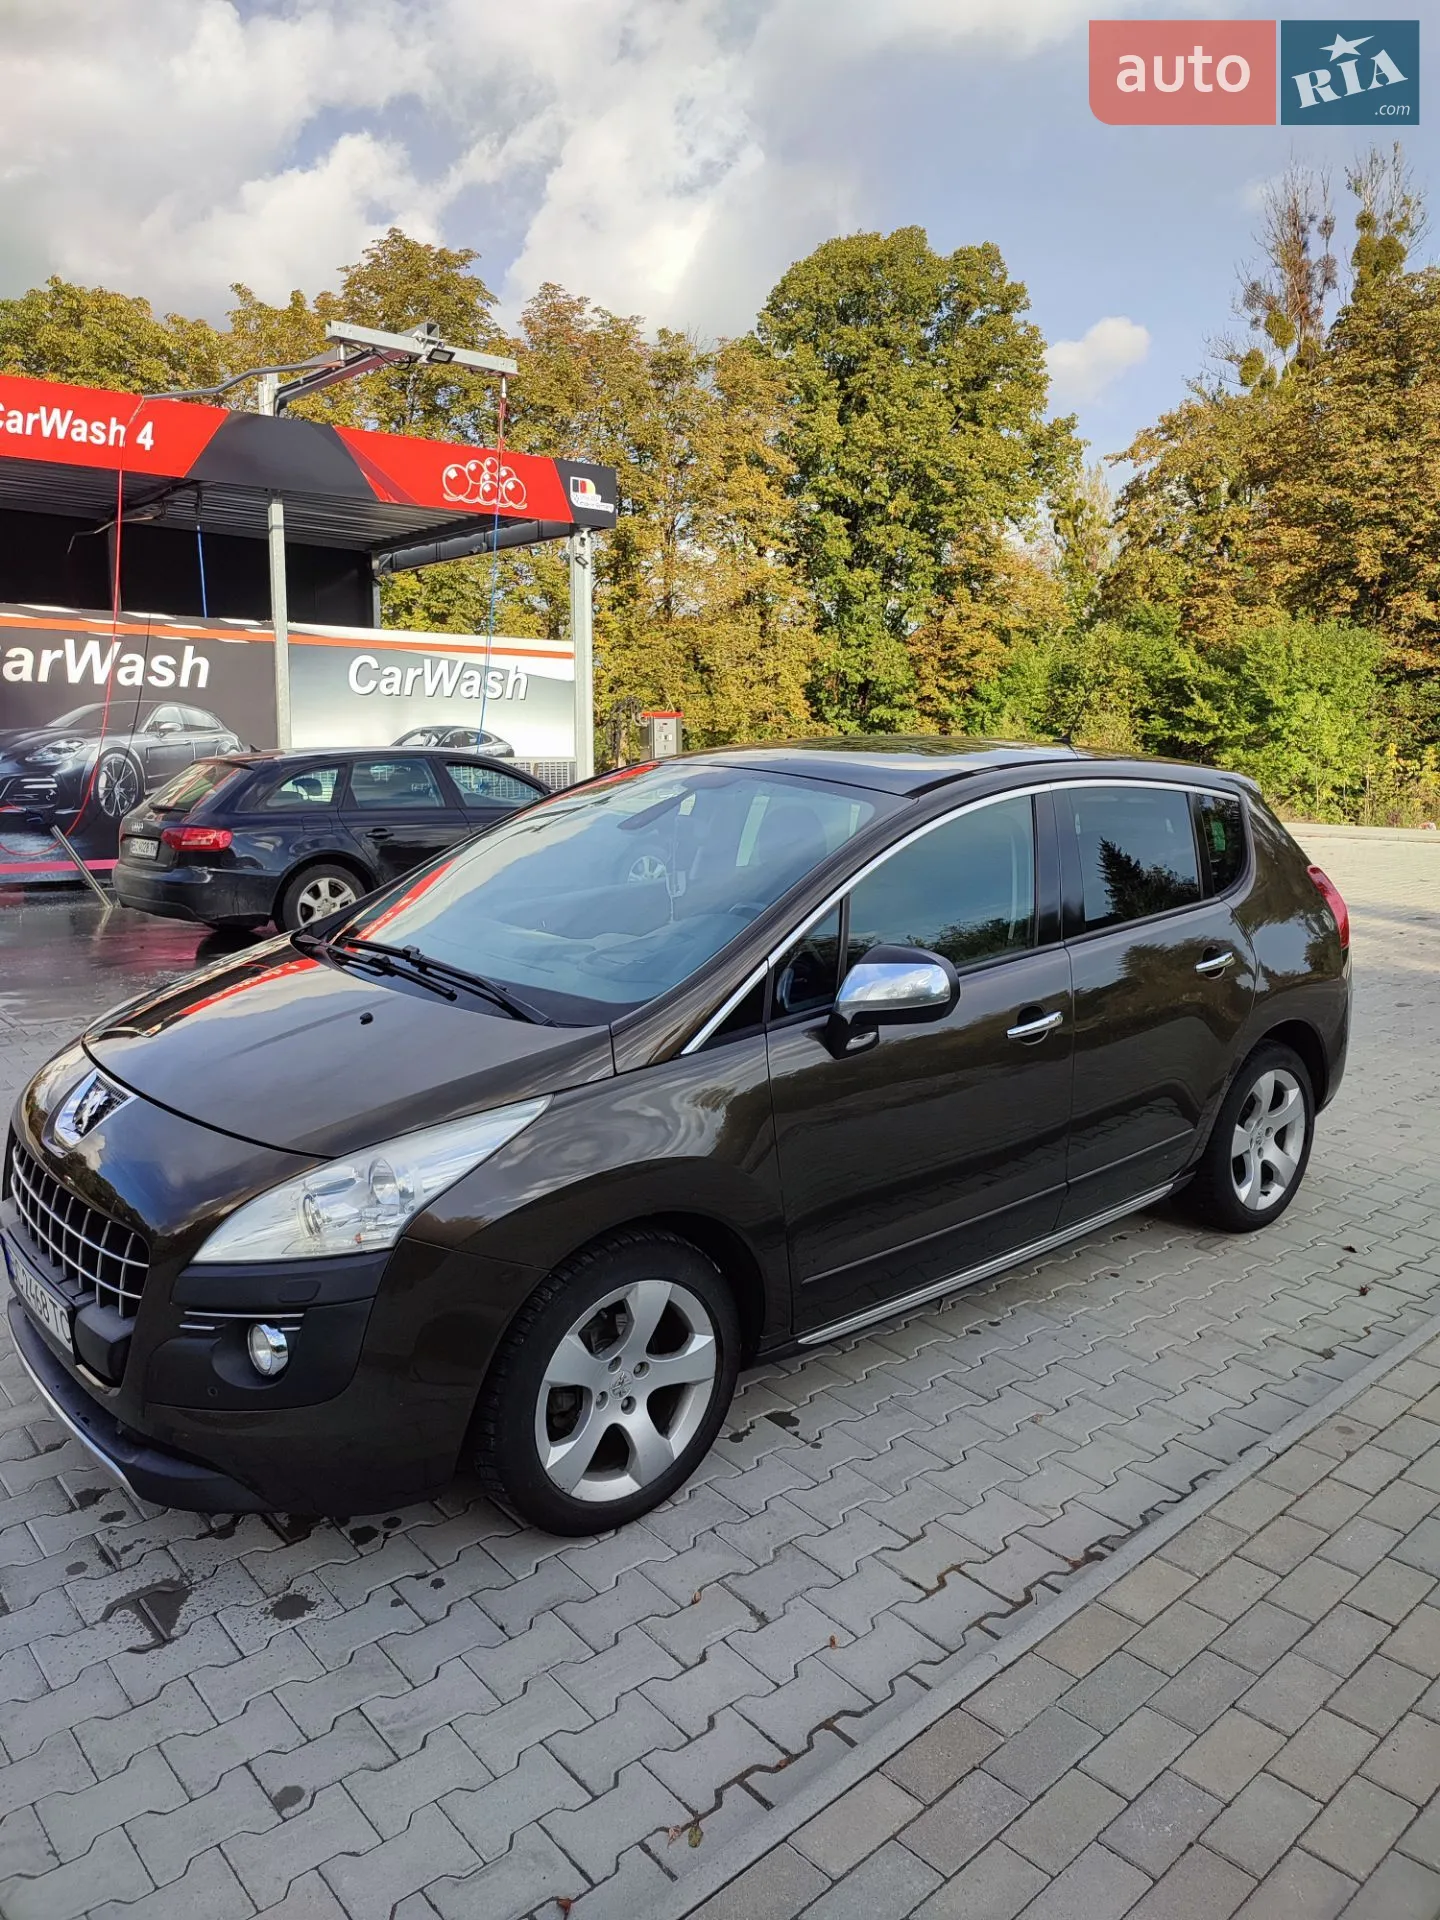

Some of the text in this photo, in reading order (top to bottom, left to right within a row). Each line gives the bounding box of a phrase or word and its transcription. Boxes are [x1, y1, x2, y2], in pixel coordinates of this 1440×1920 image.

[0, 402, 155, 451] arWash 4
[0, 638, 210, 688] arWash
[348, 654, 529, 700] CarWash
